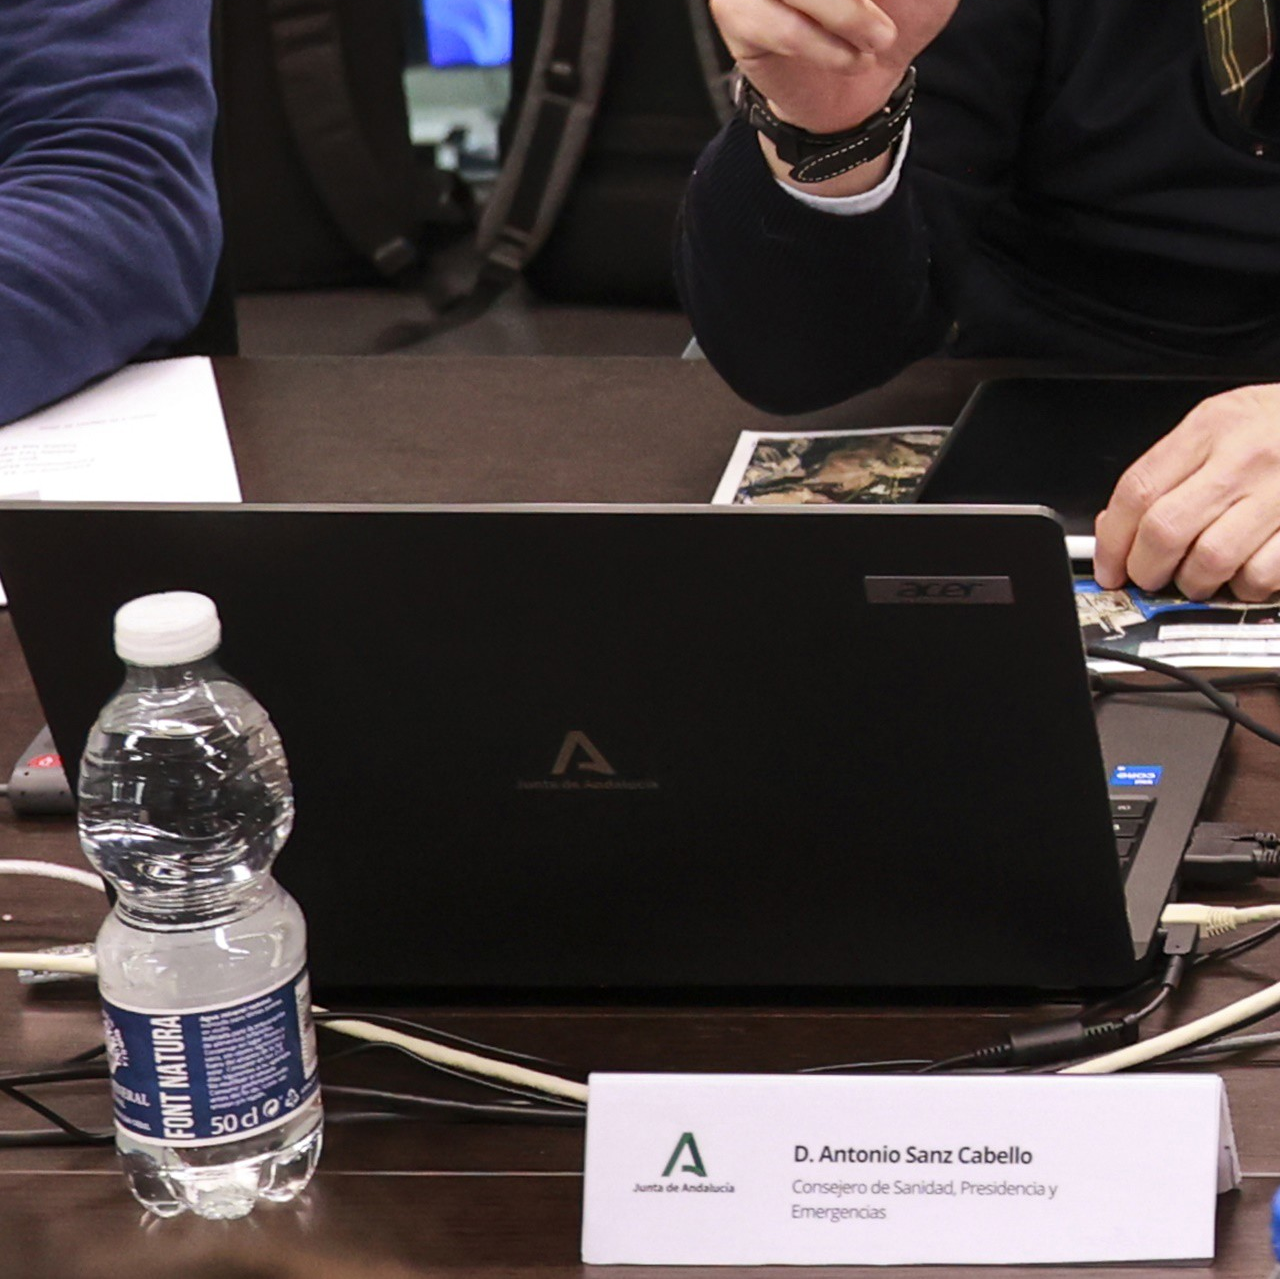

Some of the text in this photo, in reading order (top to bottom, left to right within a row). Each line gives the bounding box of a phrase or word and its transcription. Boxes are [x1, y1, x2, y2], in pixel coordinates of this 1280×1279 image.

[897, 582, 984, 598] acer
[150, 1014, 196, 1140] FONT NATURA
[210, 1106, 259, 1135] 50 cl
[794, 1144, 1034, 1165] D. Antonio Sanz Cabello
[633, 1182, 736, 1193] Junta de Andalucía
[791, 1178, 1059, 1201] Consejero de Sanidad, Presidencia y
[791, 1203, 888, 1223] Emergencias
